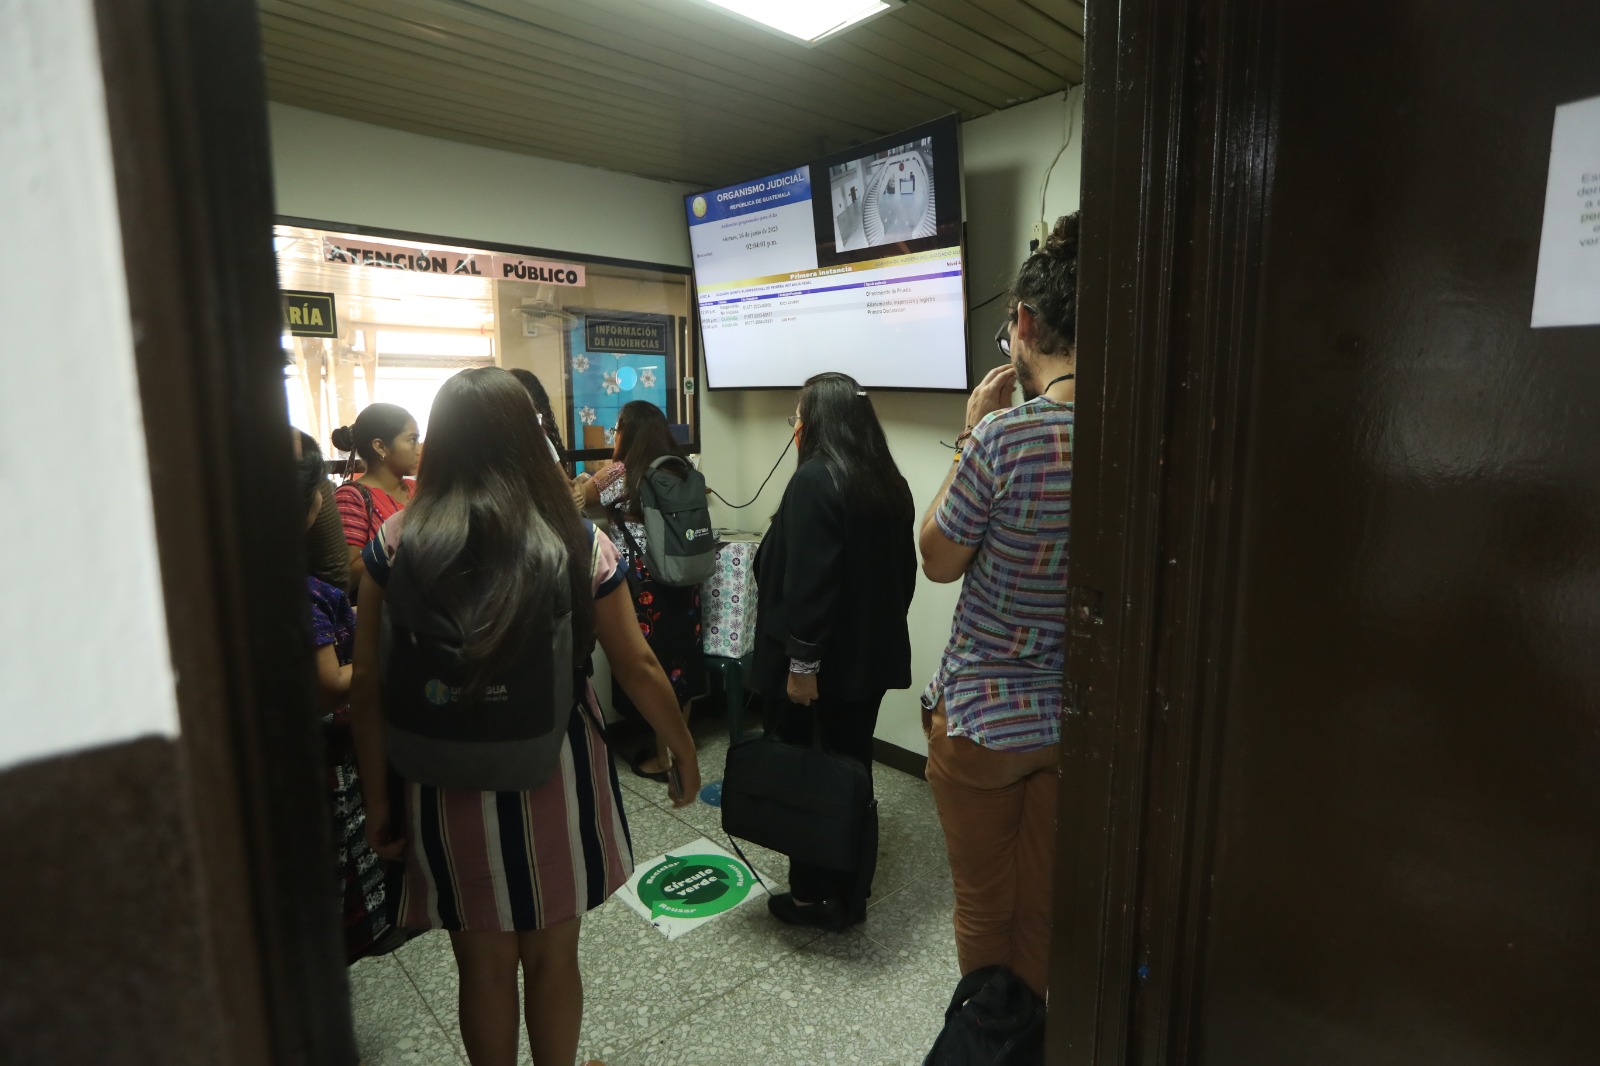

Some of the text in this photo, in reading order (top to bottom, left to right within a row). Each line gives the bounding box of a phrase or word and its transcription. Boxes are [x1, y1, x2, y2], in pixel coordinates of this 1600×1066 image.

[716, 173, 804, 202] ORGANISMO JUDICIAL
[762, 191, 791, 203] GUATEMALA
[328, 245, 578, 285] ATENCIÓN AL PÚBLICO
[789, 266, 852, 280] Primera instancia
[286, 302, 324, 326] RÍA
[595, 325, 657, 337] INFORMACIÓN
[594, 337, 660, 349] DE AUDIENCIAS
[663, 868, 714, 893] Círculo
[676, 876, 718, 896] verde
[658, 903, 697, 913] Reusar
